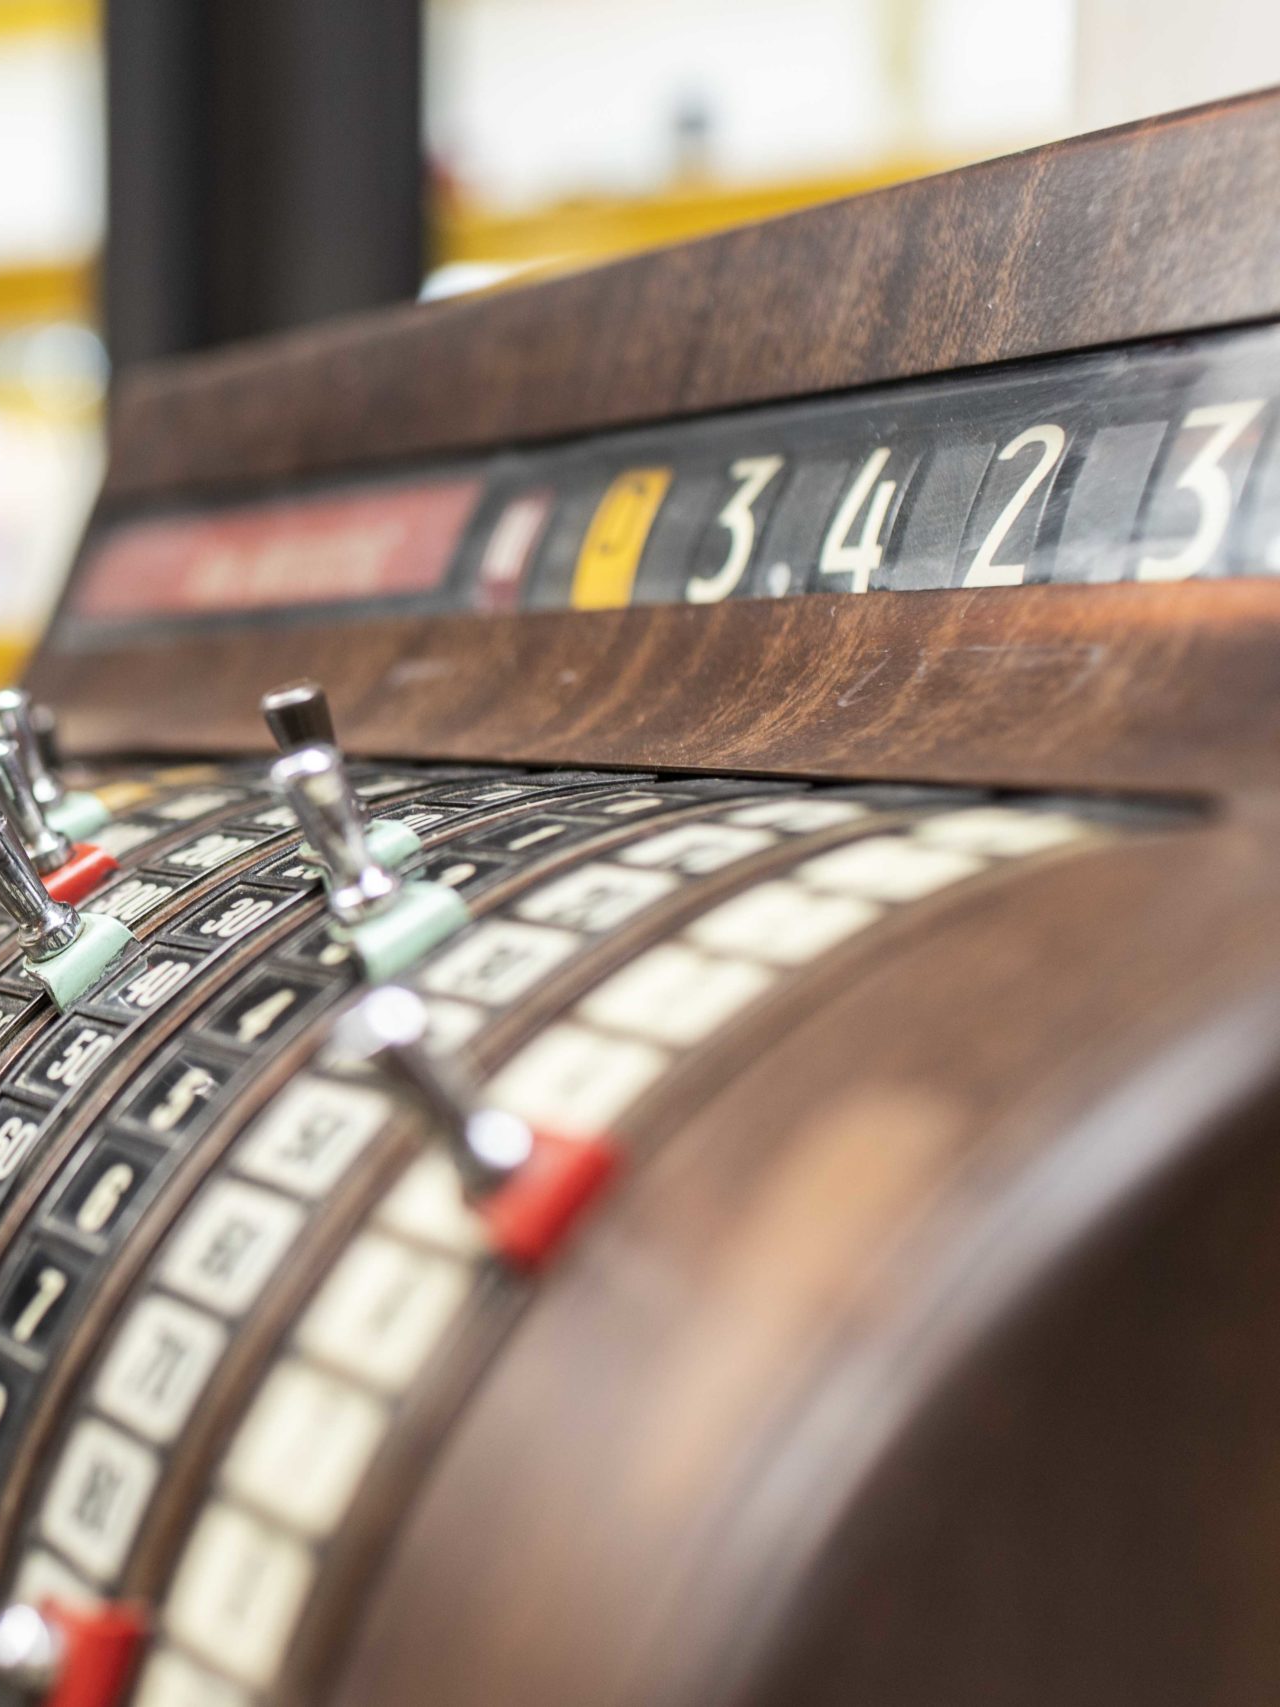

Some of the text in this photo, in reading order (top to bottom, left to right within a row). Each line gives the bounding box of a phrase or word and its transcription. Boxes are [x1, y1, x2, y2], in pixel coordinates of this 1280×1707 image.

[199, 897, 274, 938] 30
[124, 959, 192, 1008] 40
[45, 1028, 114, 1087] 50
